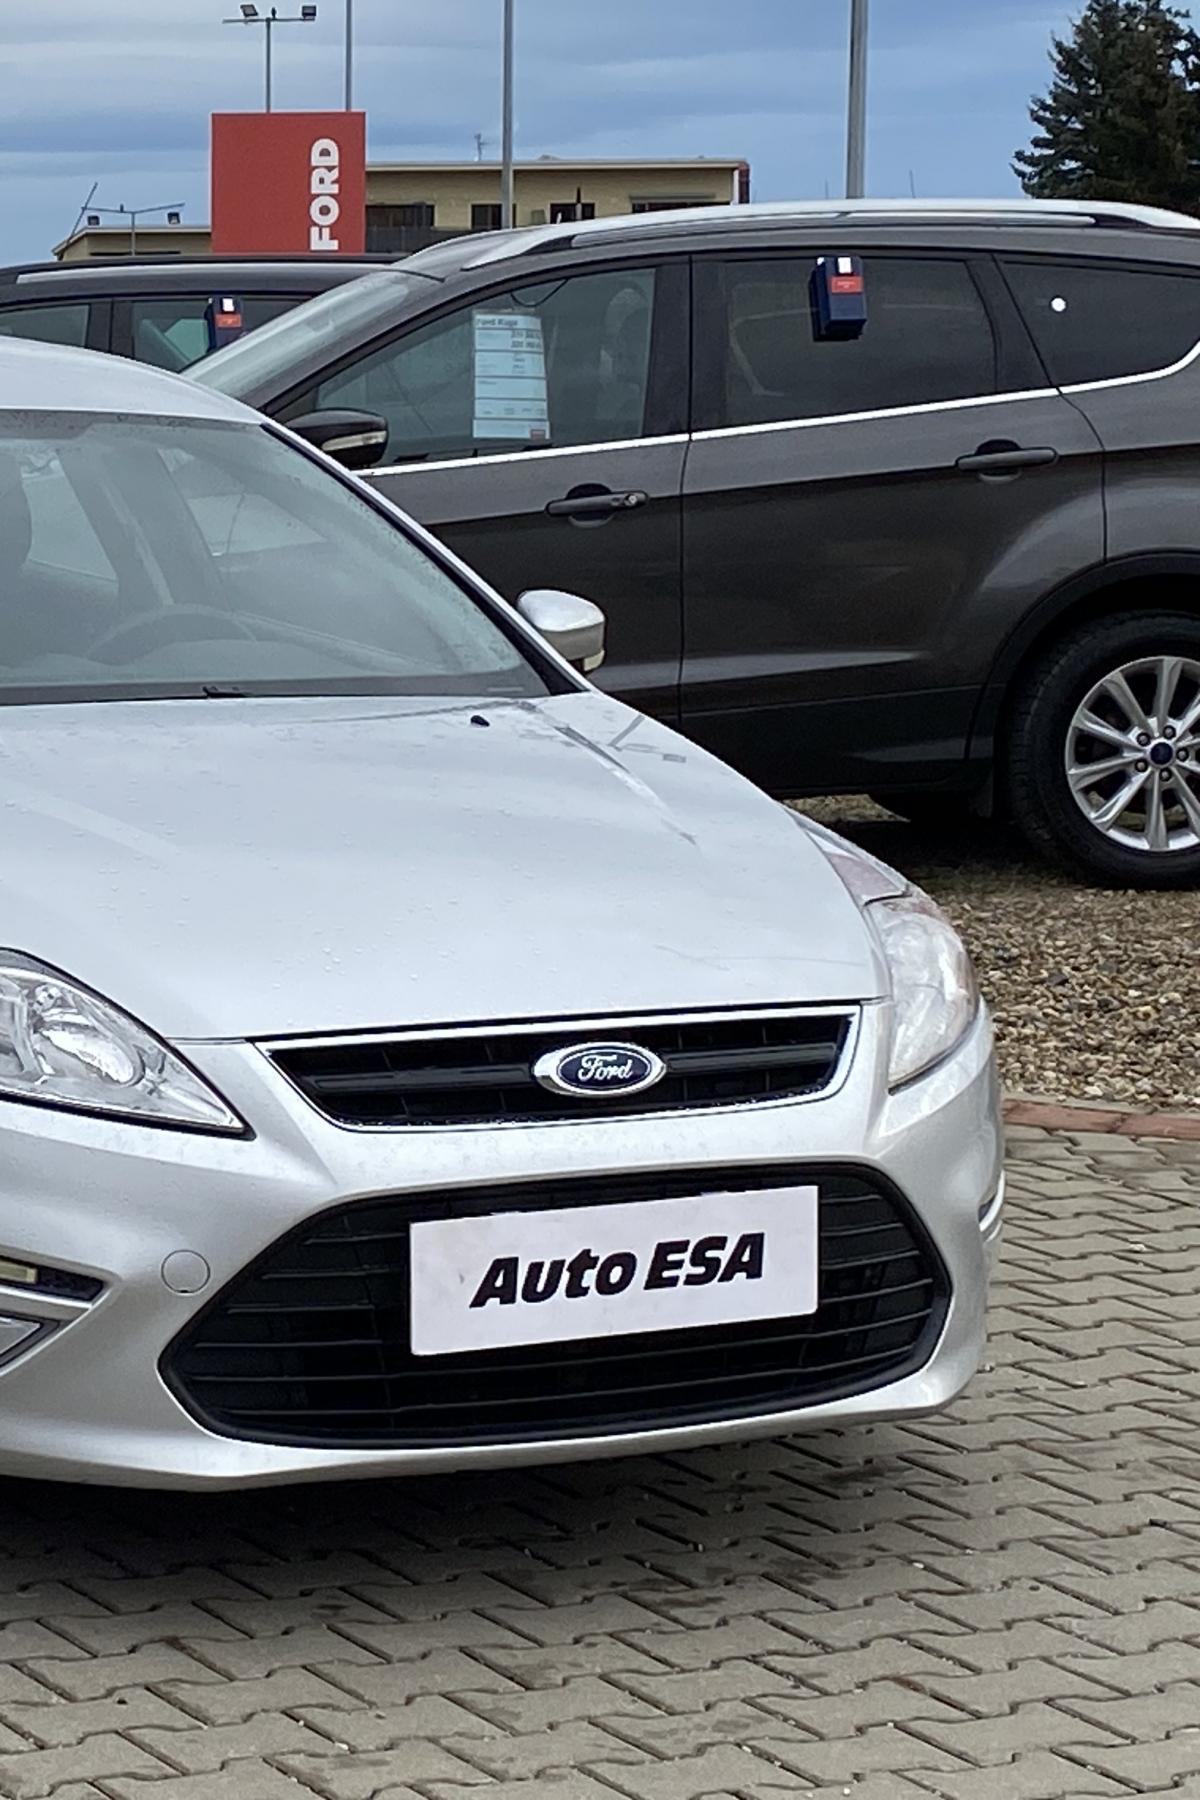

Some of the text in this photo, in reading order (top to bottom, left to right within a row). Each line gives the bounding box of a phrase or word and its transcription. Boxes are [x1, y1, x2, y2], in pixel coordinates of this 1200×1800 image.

[309, 138, 339, 251] FORD
[577, 1054, 635, 1082] Ford
[469, 1232, 766, 1309] Auto ESA
